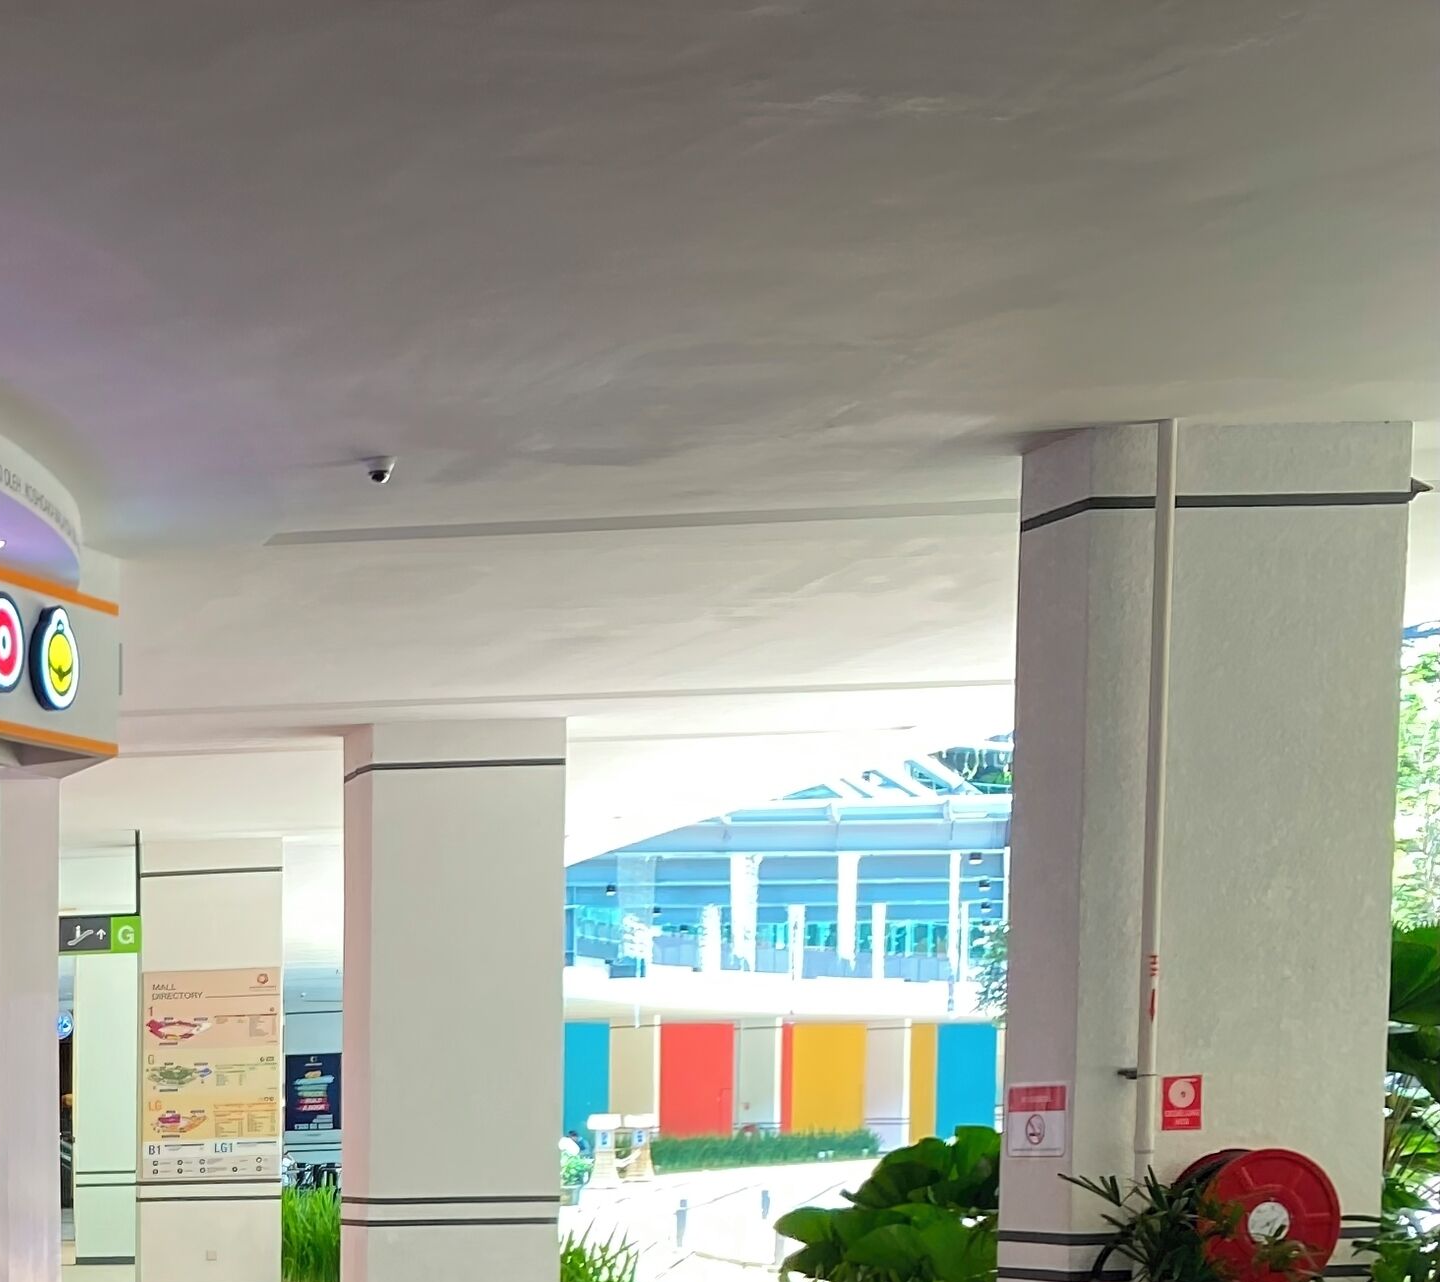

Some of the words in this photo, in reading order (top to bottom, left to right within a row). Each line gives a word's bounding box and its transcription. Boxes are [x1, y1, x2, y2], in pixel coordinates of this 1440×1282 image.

[117, 924, 135, 945] G
[152, 983, 176, 991] MALL
[151, 991, 203, 1001] DIRECTORY
[148, 1100, 162, 1111] LG
[148, 1144, 161, 1155] B1
[214, 1142, 233, 1153] LG1
